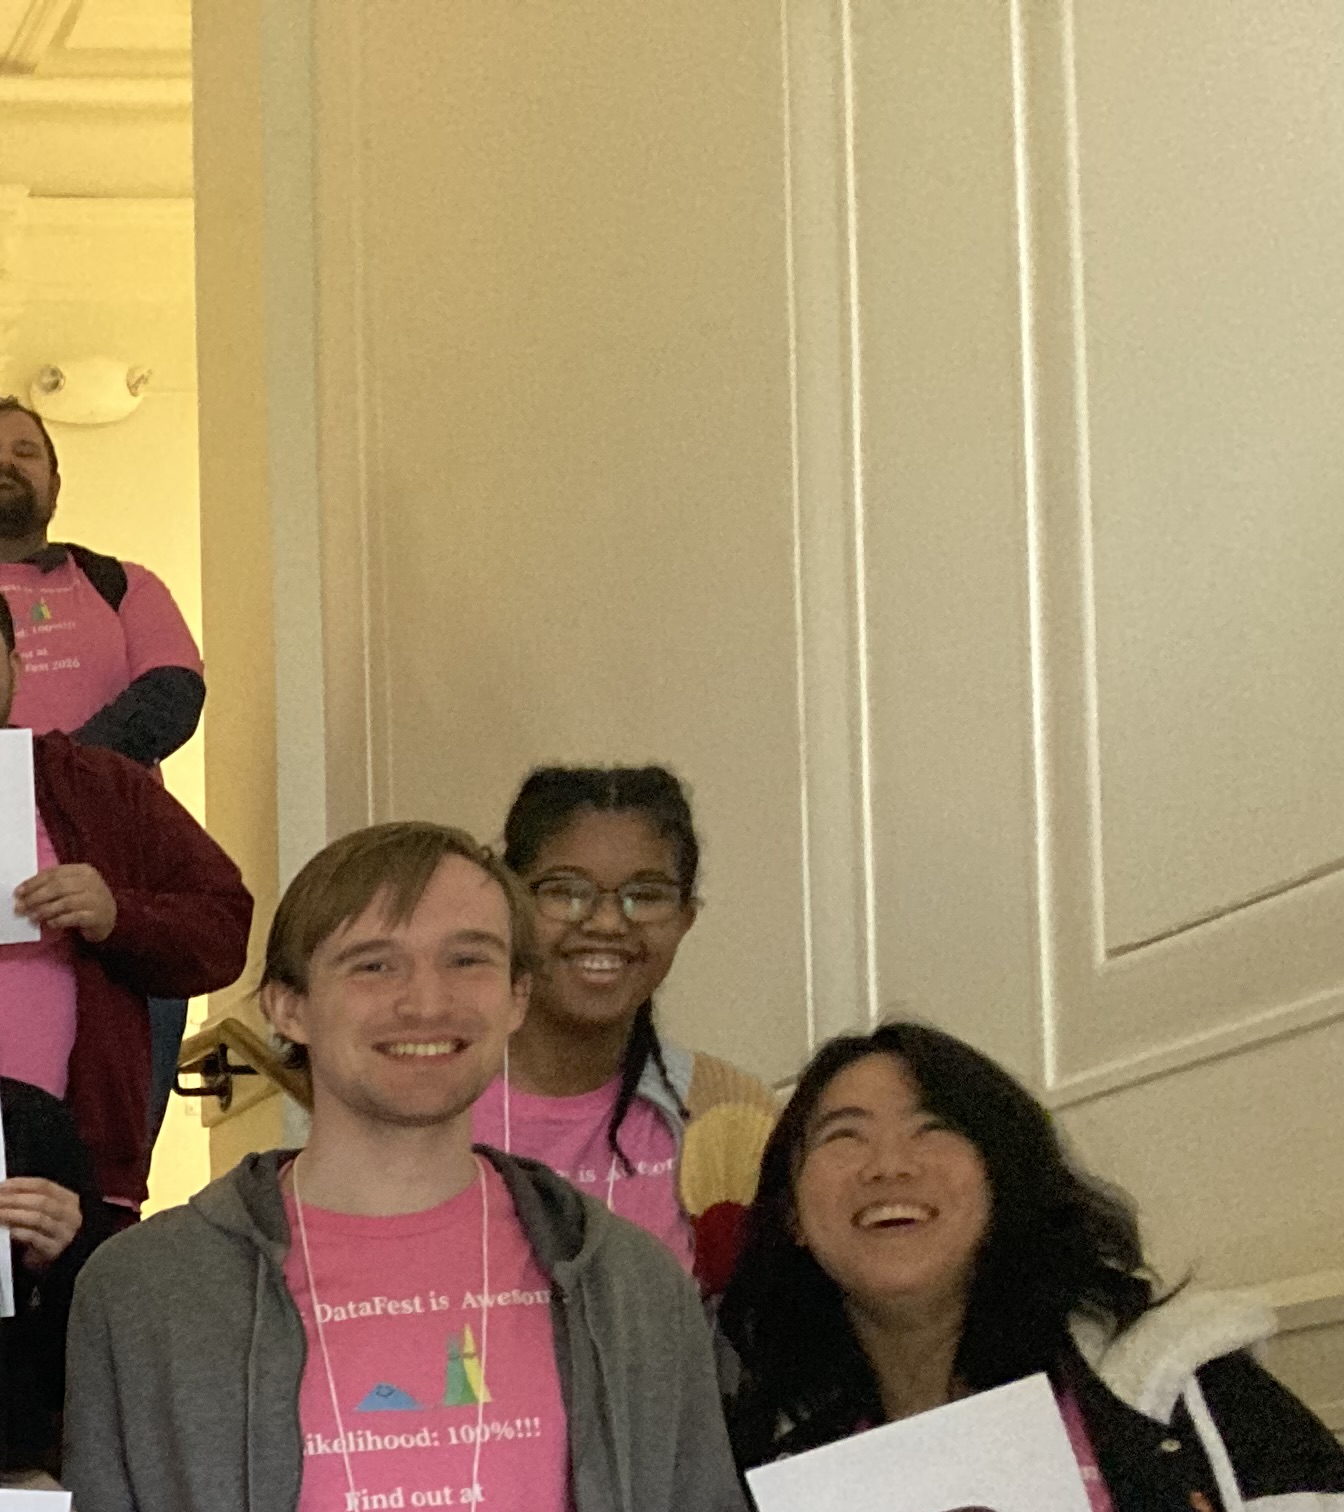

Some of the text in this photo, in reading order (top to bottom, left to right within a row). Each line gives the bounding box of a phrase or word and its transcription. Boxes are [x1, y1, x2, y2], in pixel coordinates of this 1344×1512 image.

[315, 1291, 425, 1324] DataFest
[430, 1290, 450, 1312] is
[303, 1417, 542, 1456] ikelihood: 100%!!!
[345, 1483, 485, 1512] Find out at
